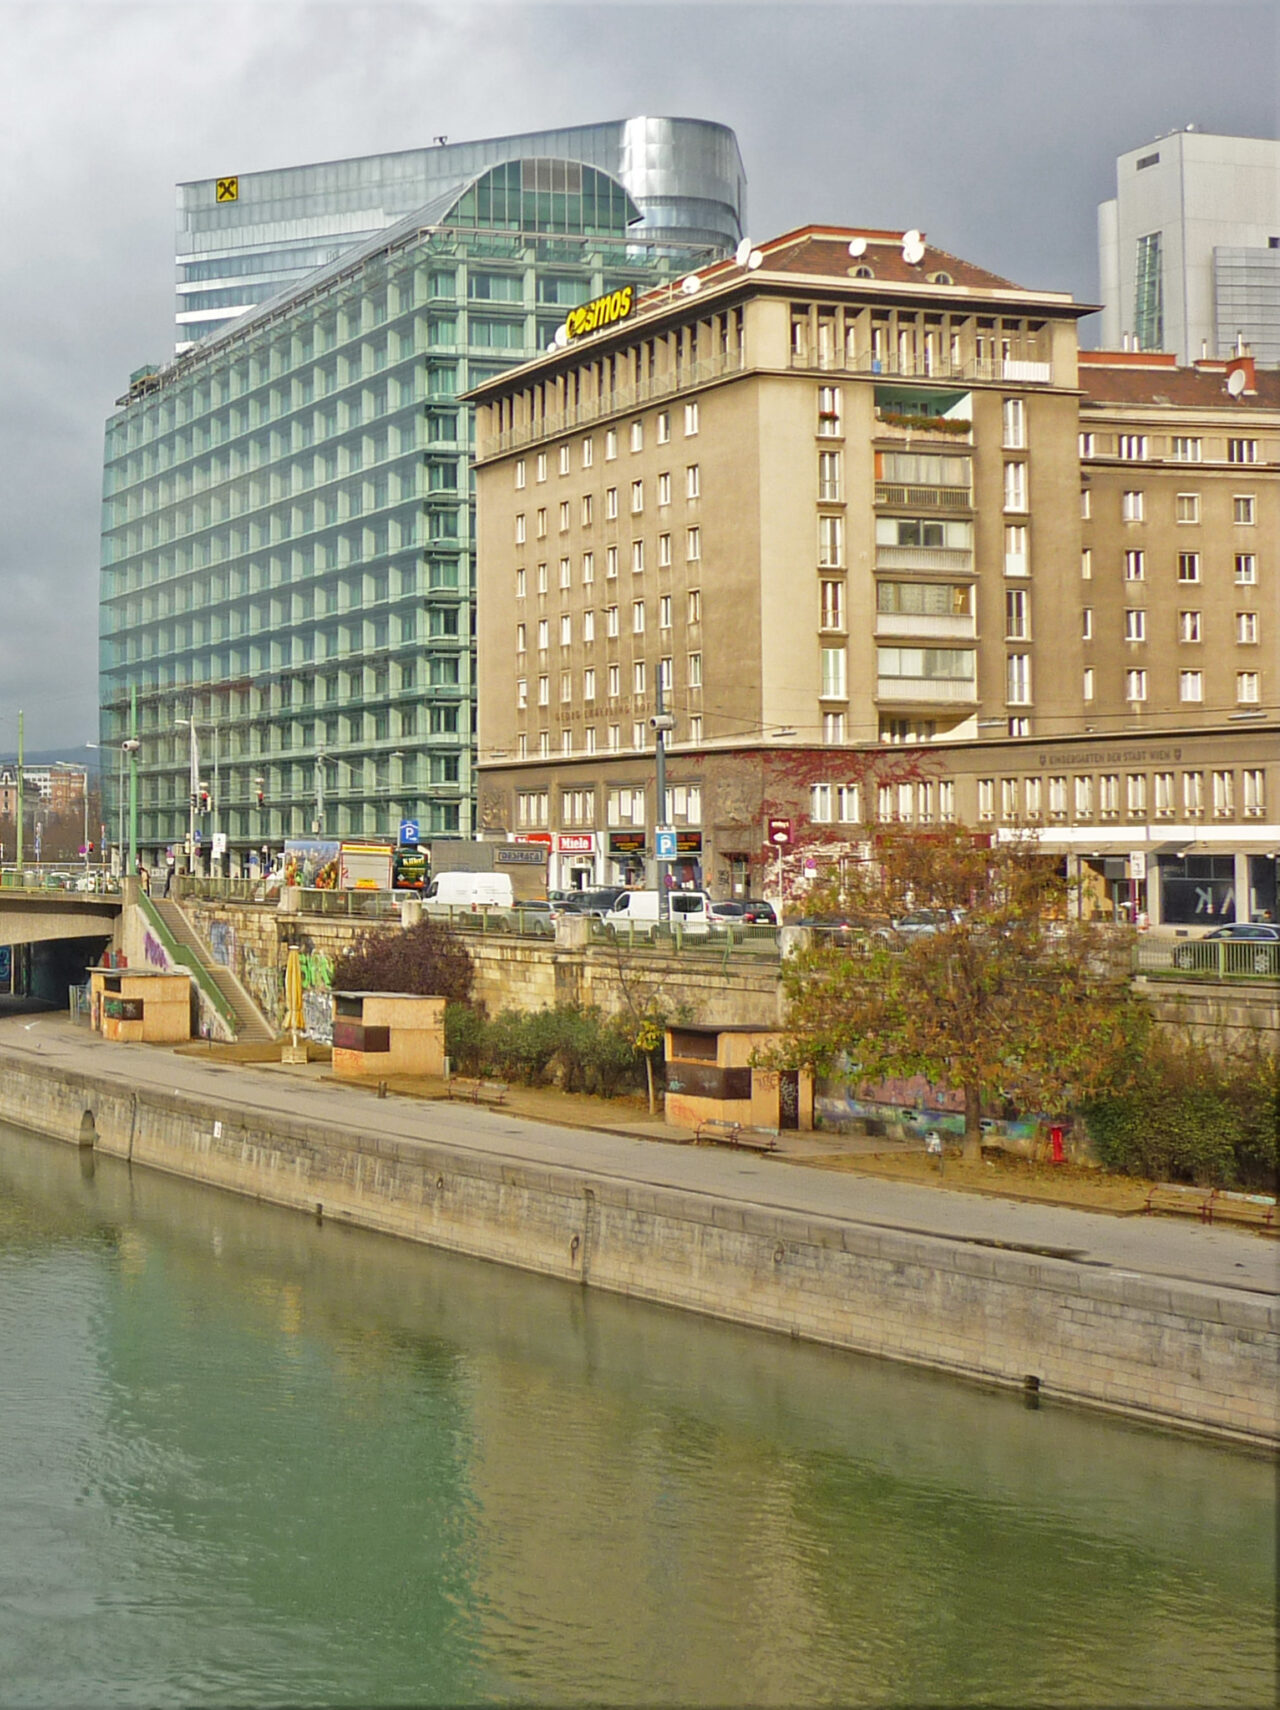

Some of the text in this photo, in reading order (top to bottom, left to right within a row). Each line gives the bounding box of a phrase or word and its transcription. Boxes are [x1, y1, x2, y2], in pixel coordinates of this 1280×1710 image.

[406, 827, 414, 839] P
[561, 837, 589, 849] Miele
[661, 839, 671, 853] P
